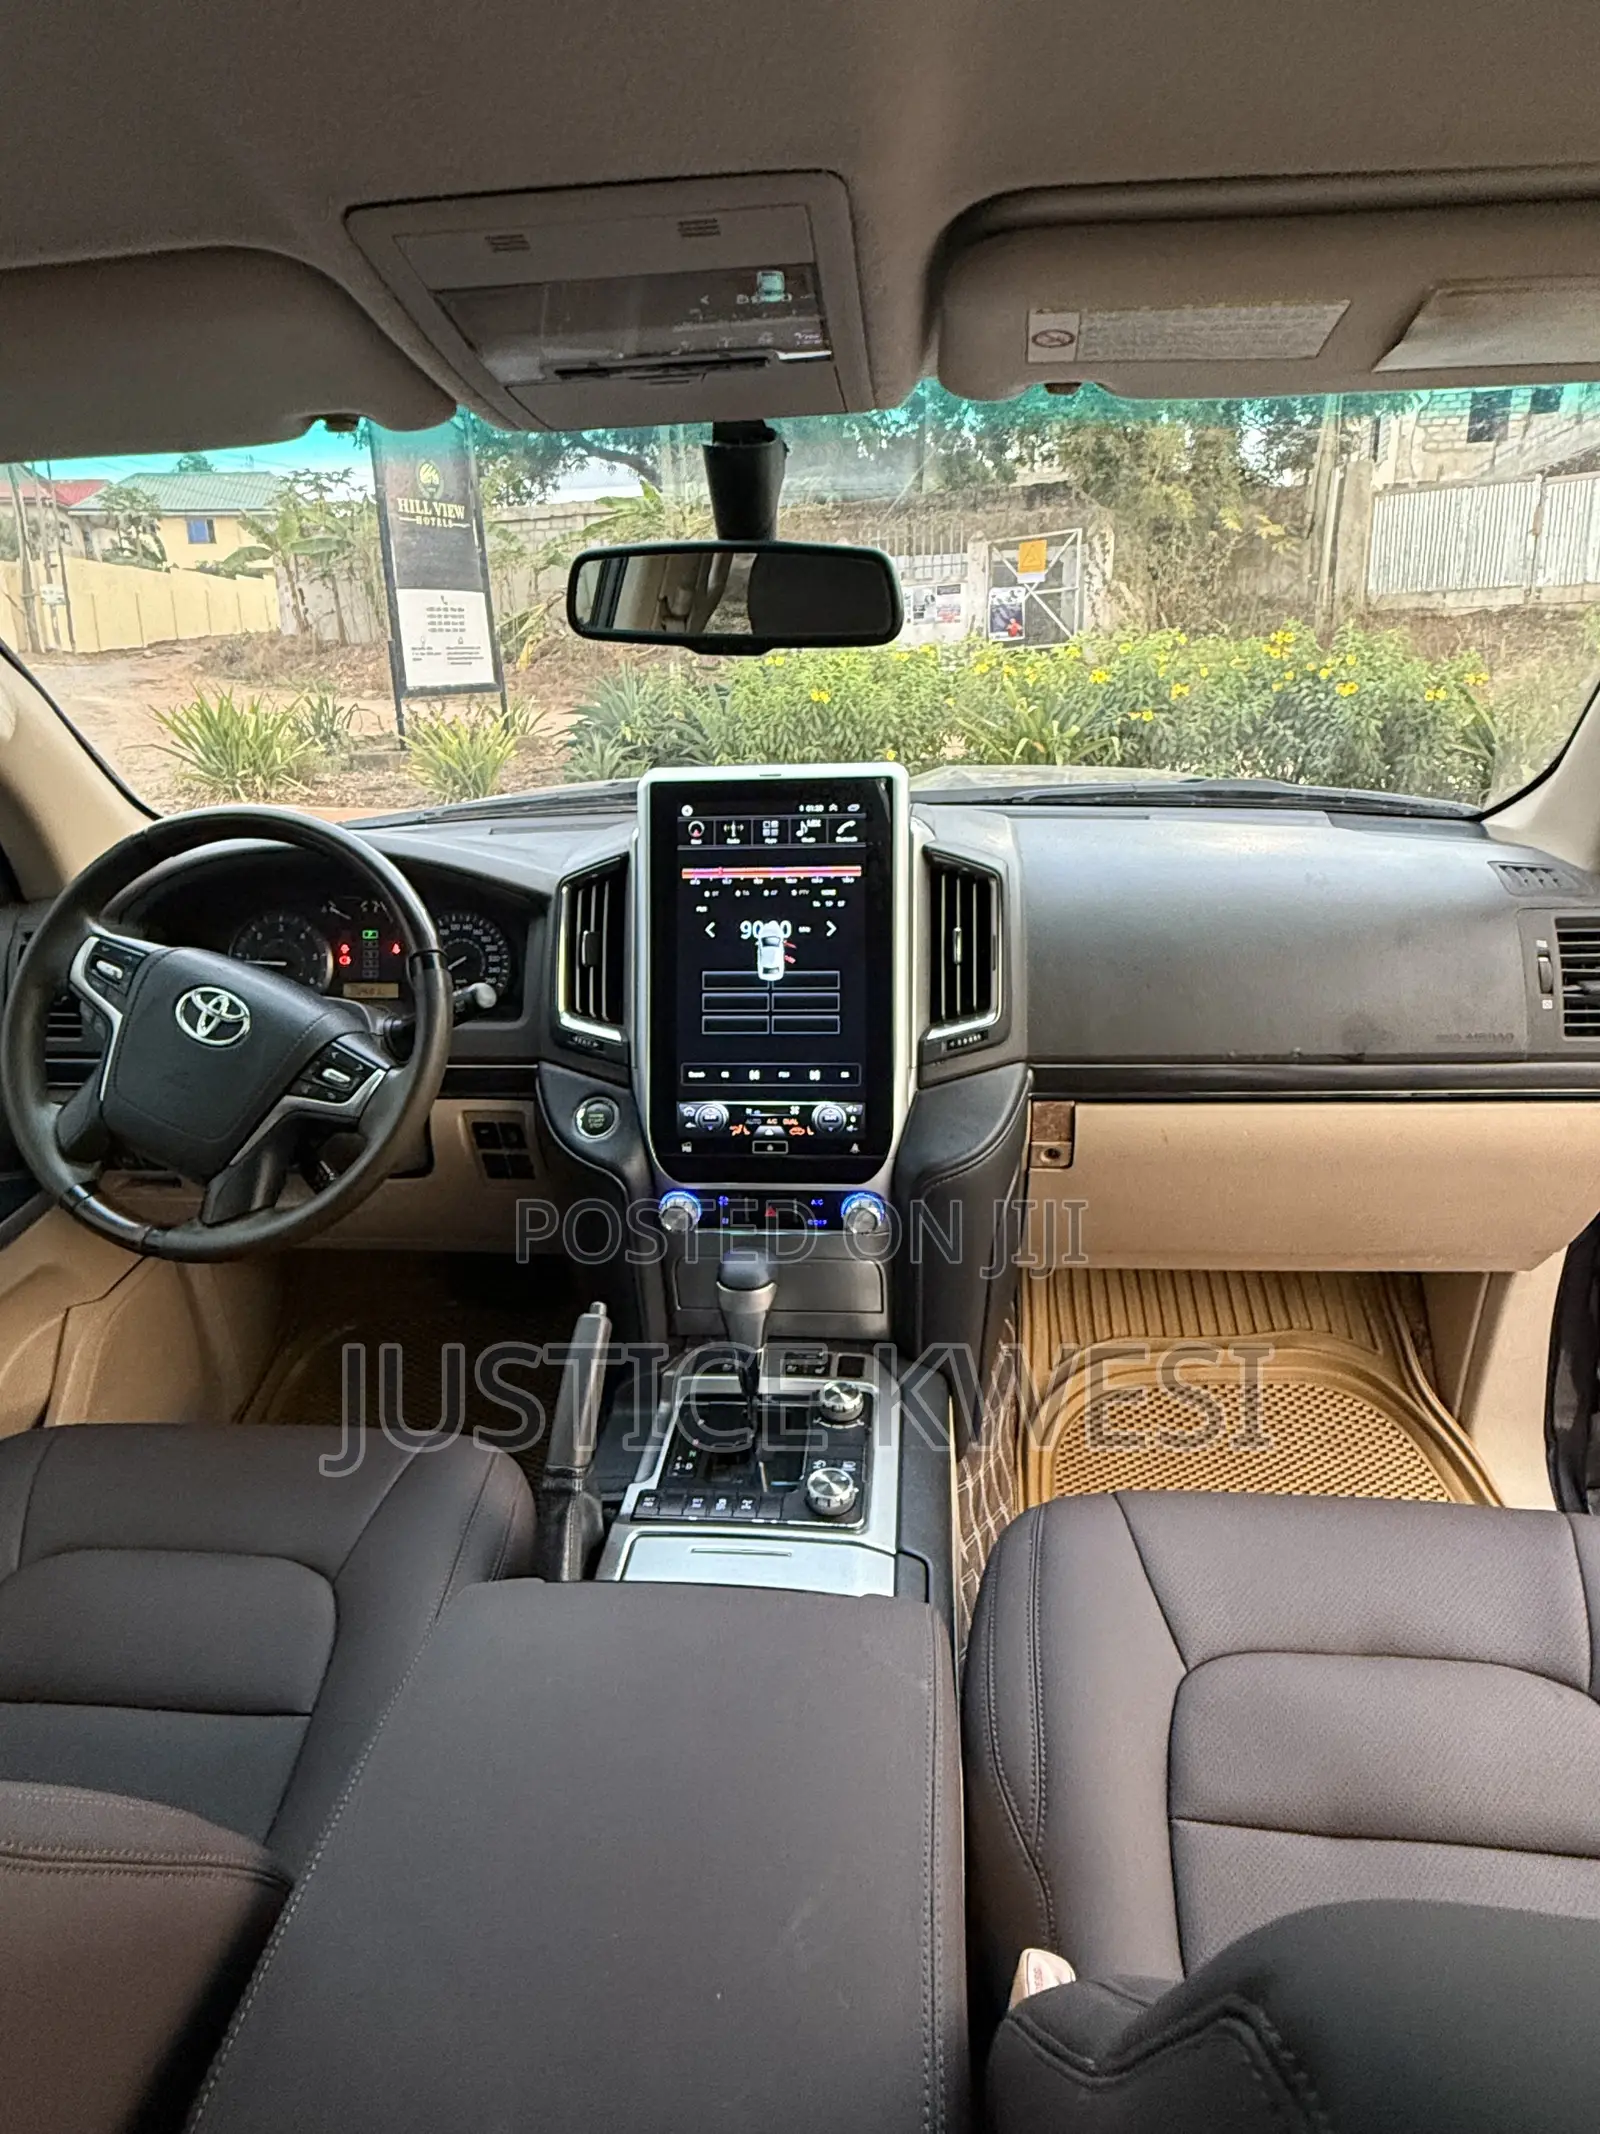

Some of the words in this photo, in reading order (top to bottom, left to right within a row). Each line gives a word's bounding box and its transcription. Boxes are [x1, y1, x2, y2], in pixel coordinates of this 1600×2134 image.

[397, 497, 432, 515] HILL
[432, 502, 465, 519] VIEW
[416, 515, 453, 528] HOTELS
